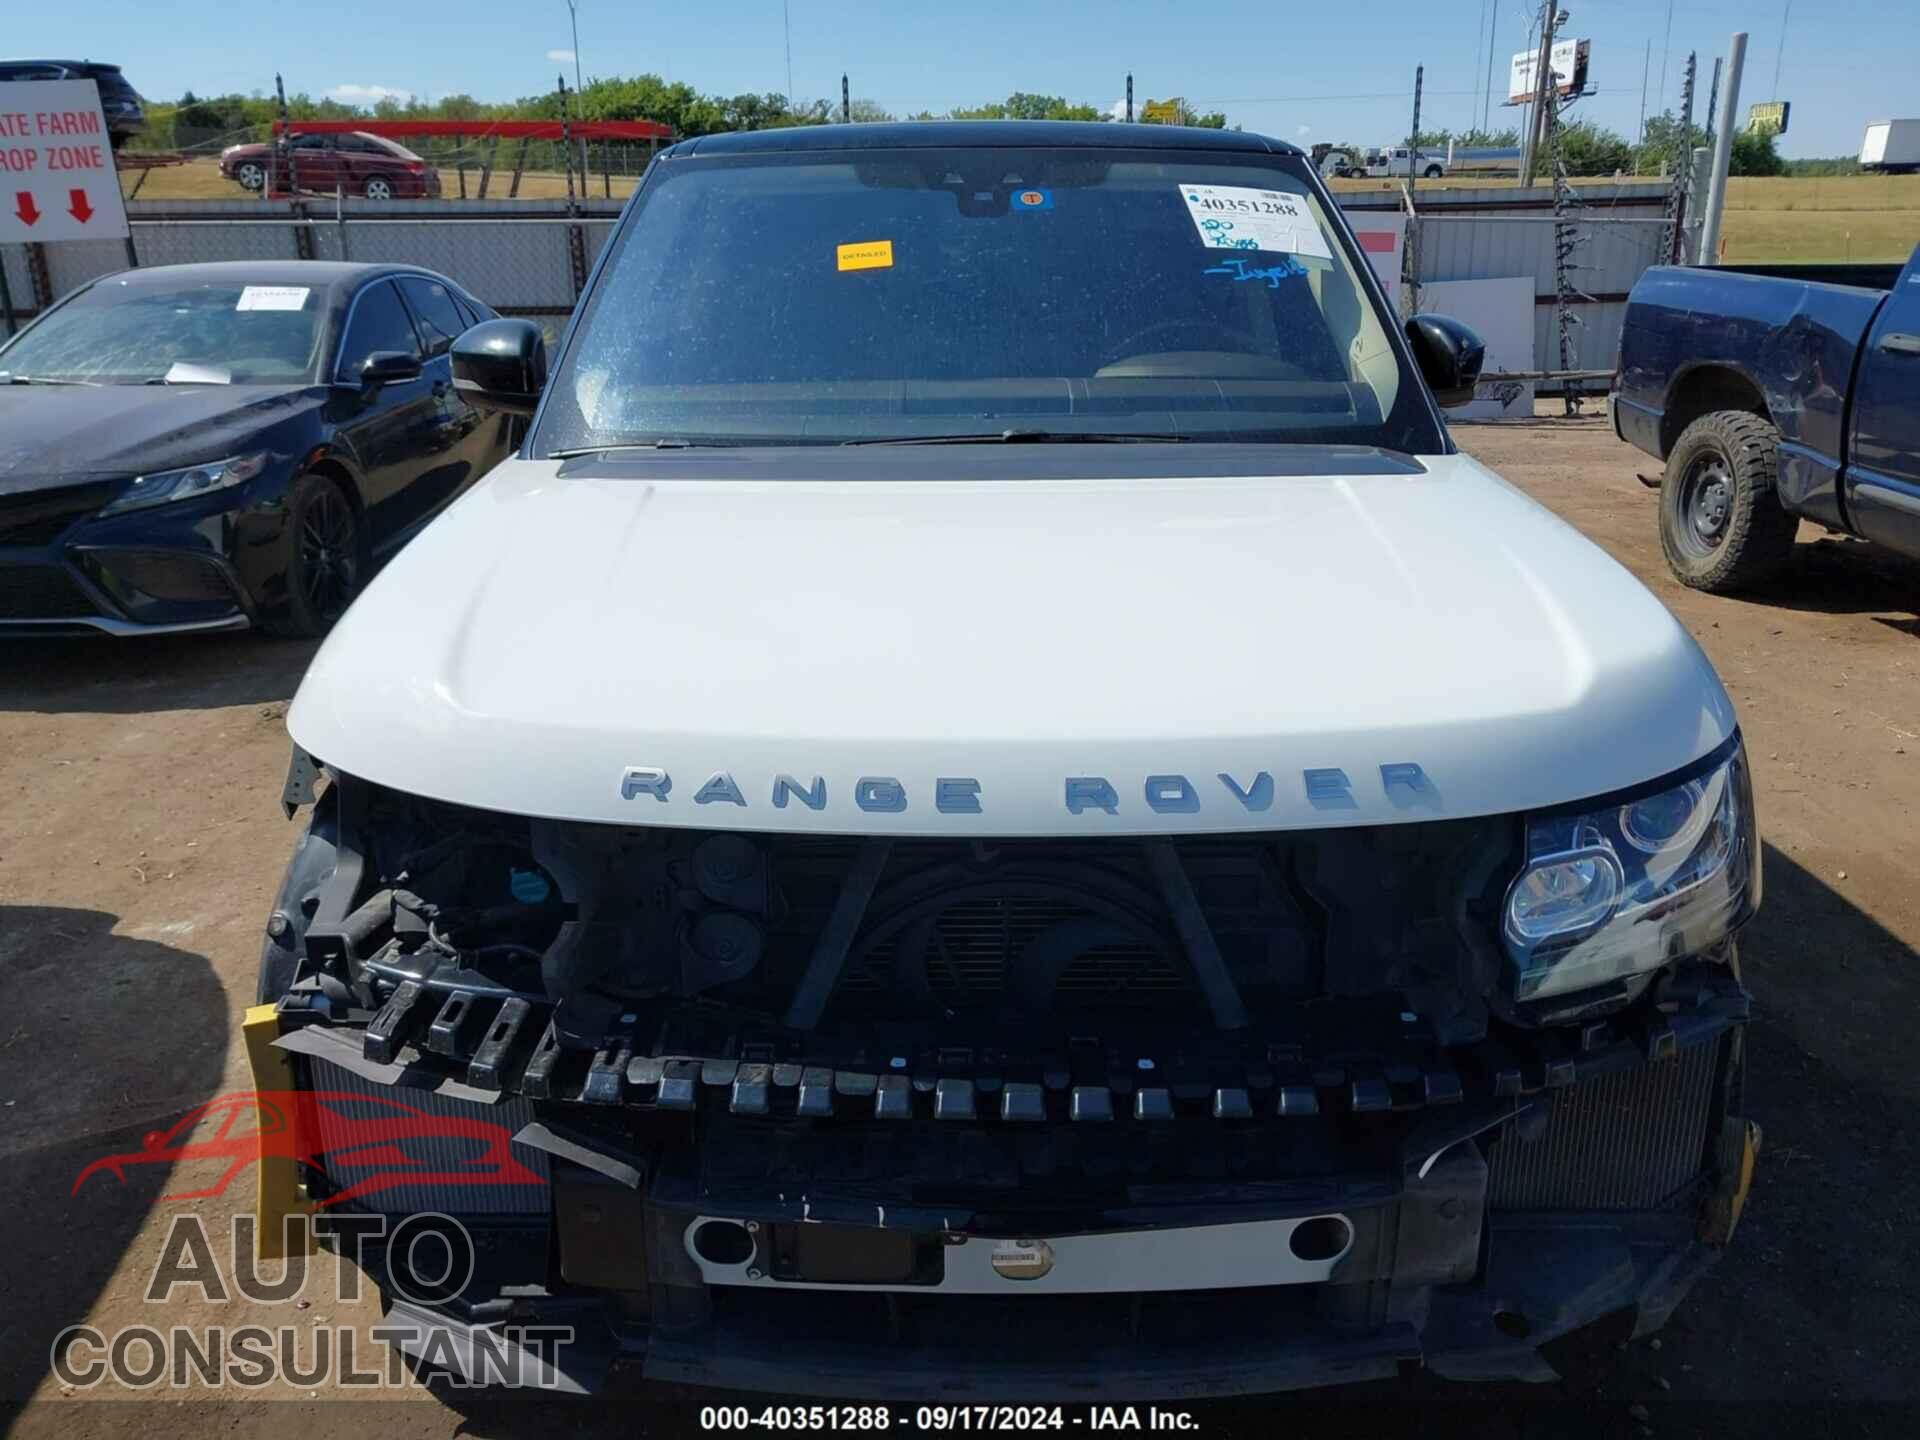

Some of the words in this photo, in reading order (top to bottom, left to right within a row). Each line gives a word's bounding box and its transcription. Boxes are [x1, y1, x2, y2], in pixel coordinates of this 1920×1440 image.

[35, 111, 100, 135] FARM
[45, 145, 104, 170] ZONE
[1200, 197, 1299, 217] 40351288
[620, 766, 984, 814] RANGE
[1065, 763, 1438, 815] ROVER
